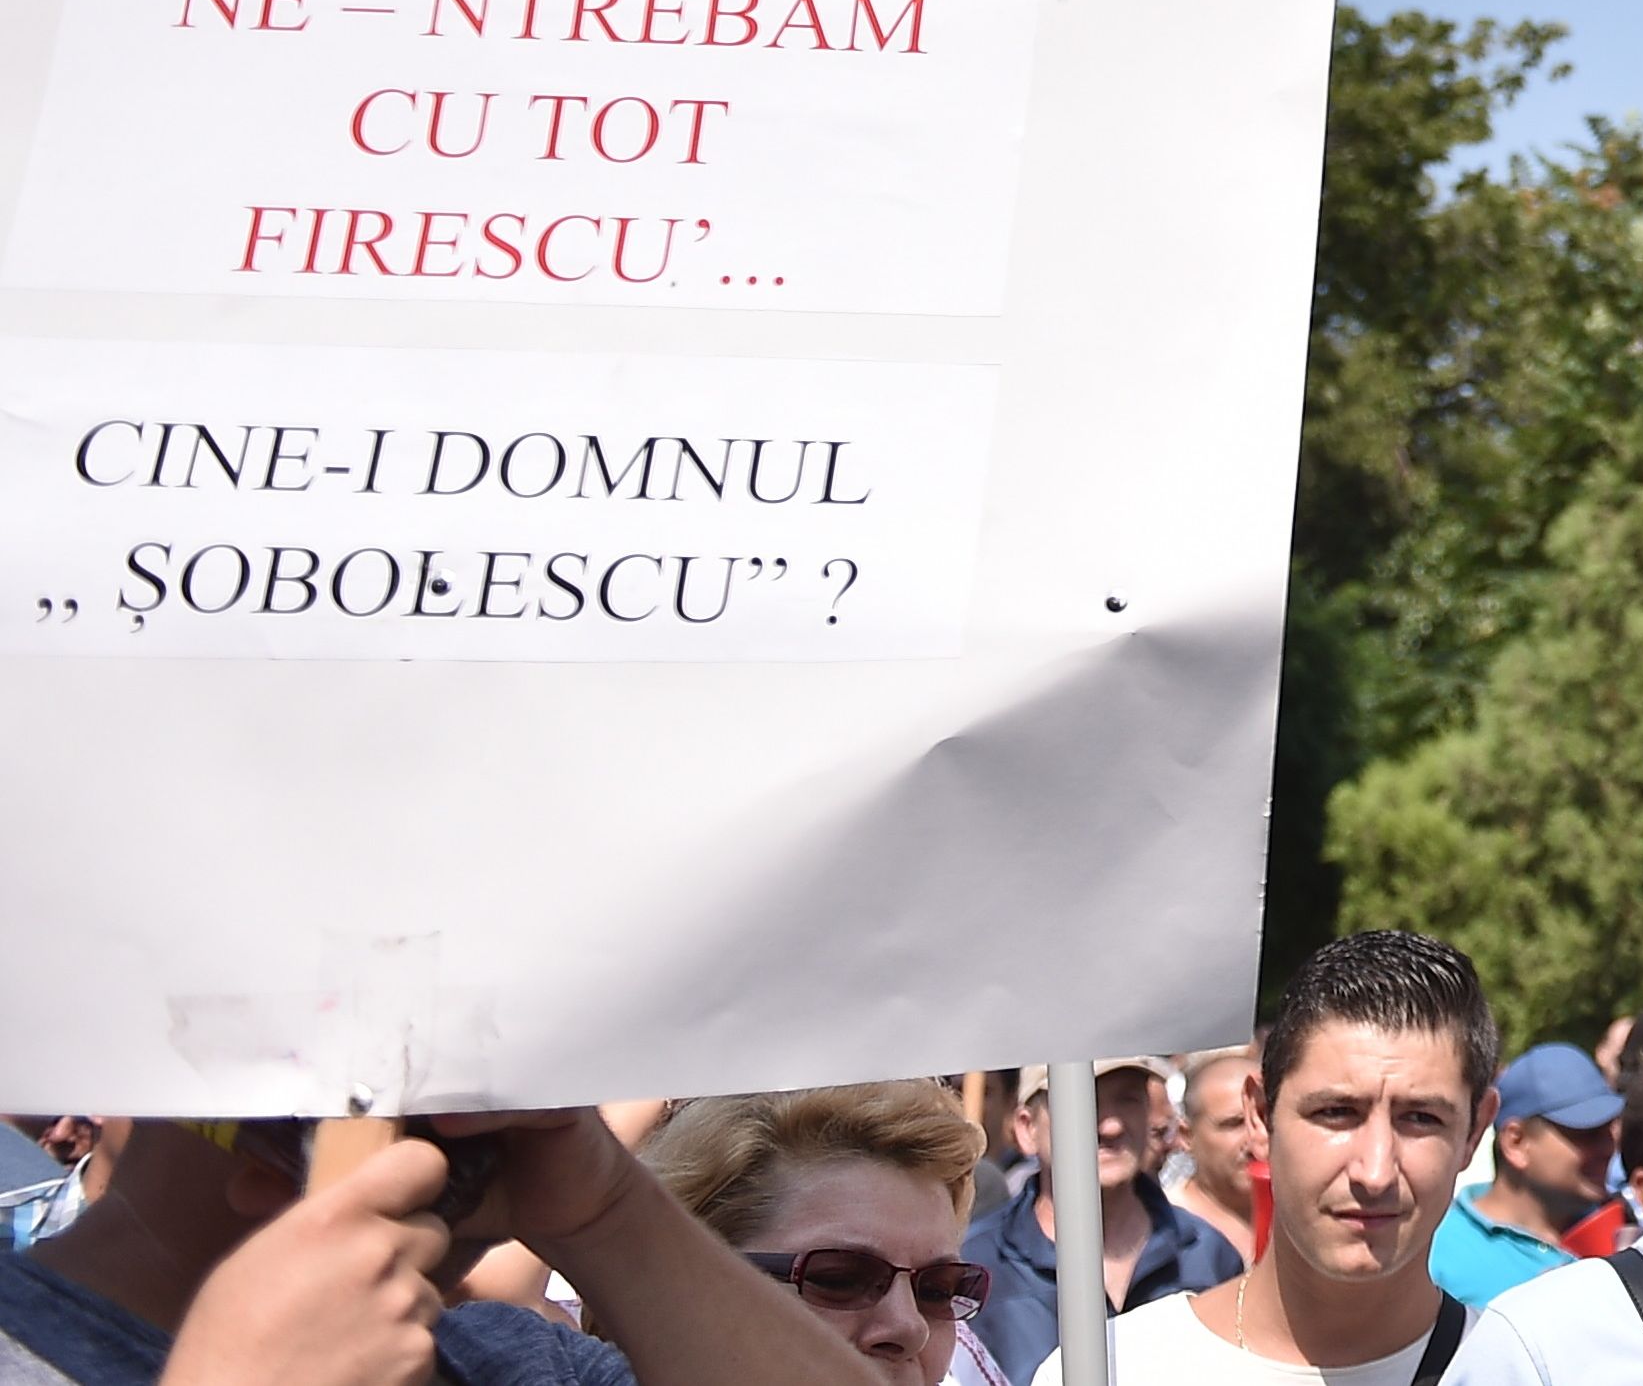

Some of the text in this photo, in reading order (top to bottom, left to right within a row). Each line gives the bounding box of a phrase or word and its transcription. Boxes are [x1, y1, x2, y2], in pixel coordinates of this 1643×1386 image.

[348, 89, 730, 165] CU TOT
[74, 418, 873, 506] CINE-I DOMNUL
[820, 557, 859, 626] ?
